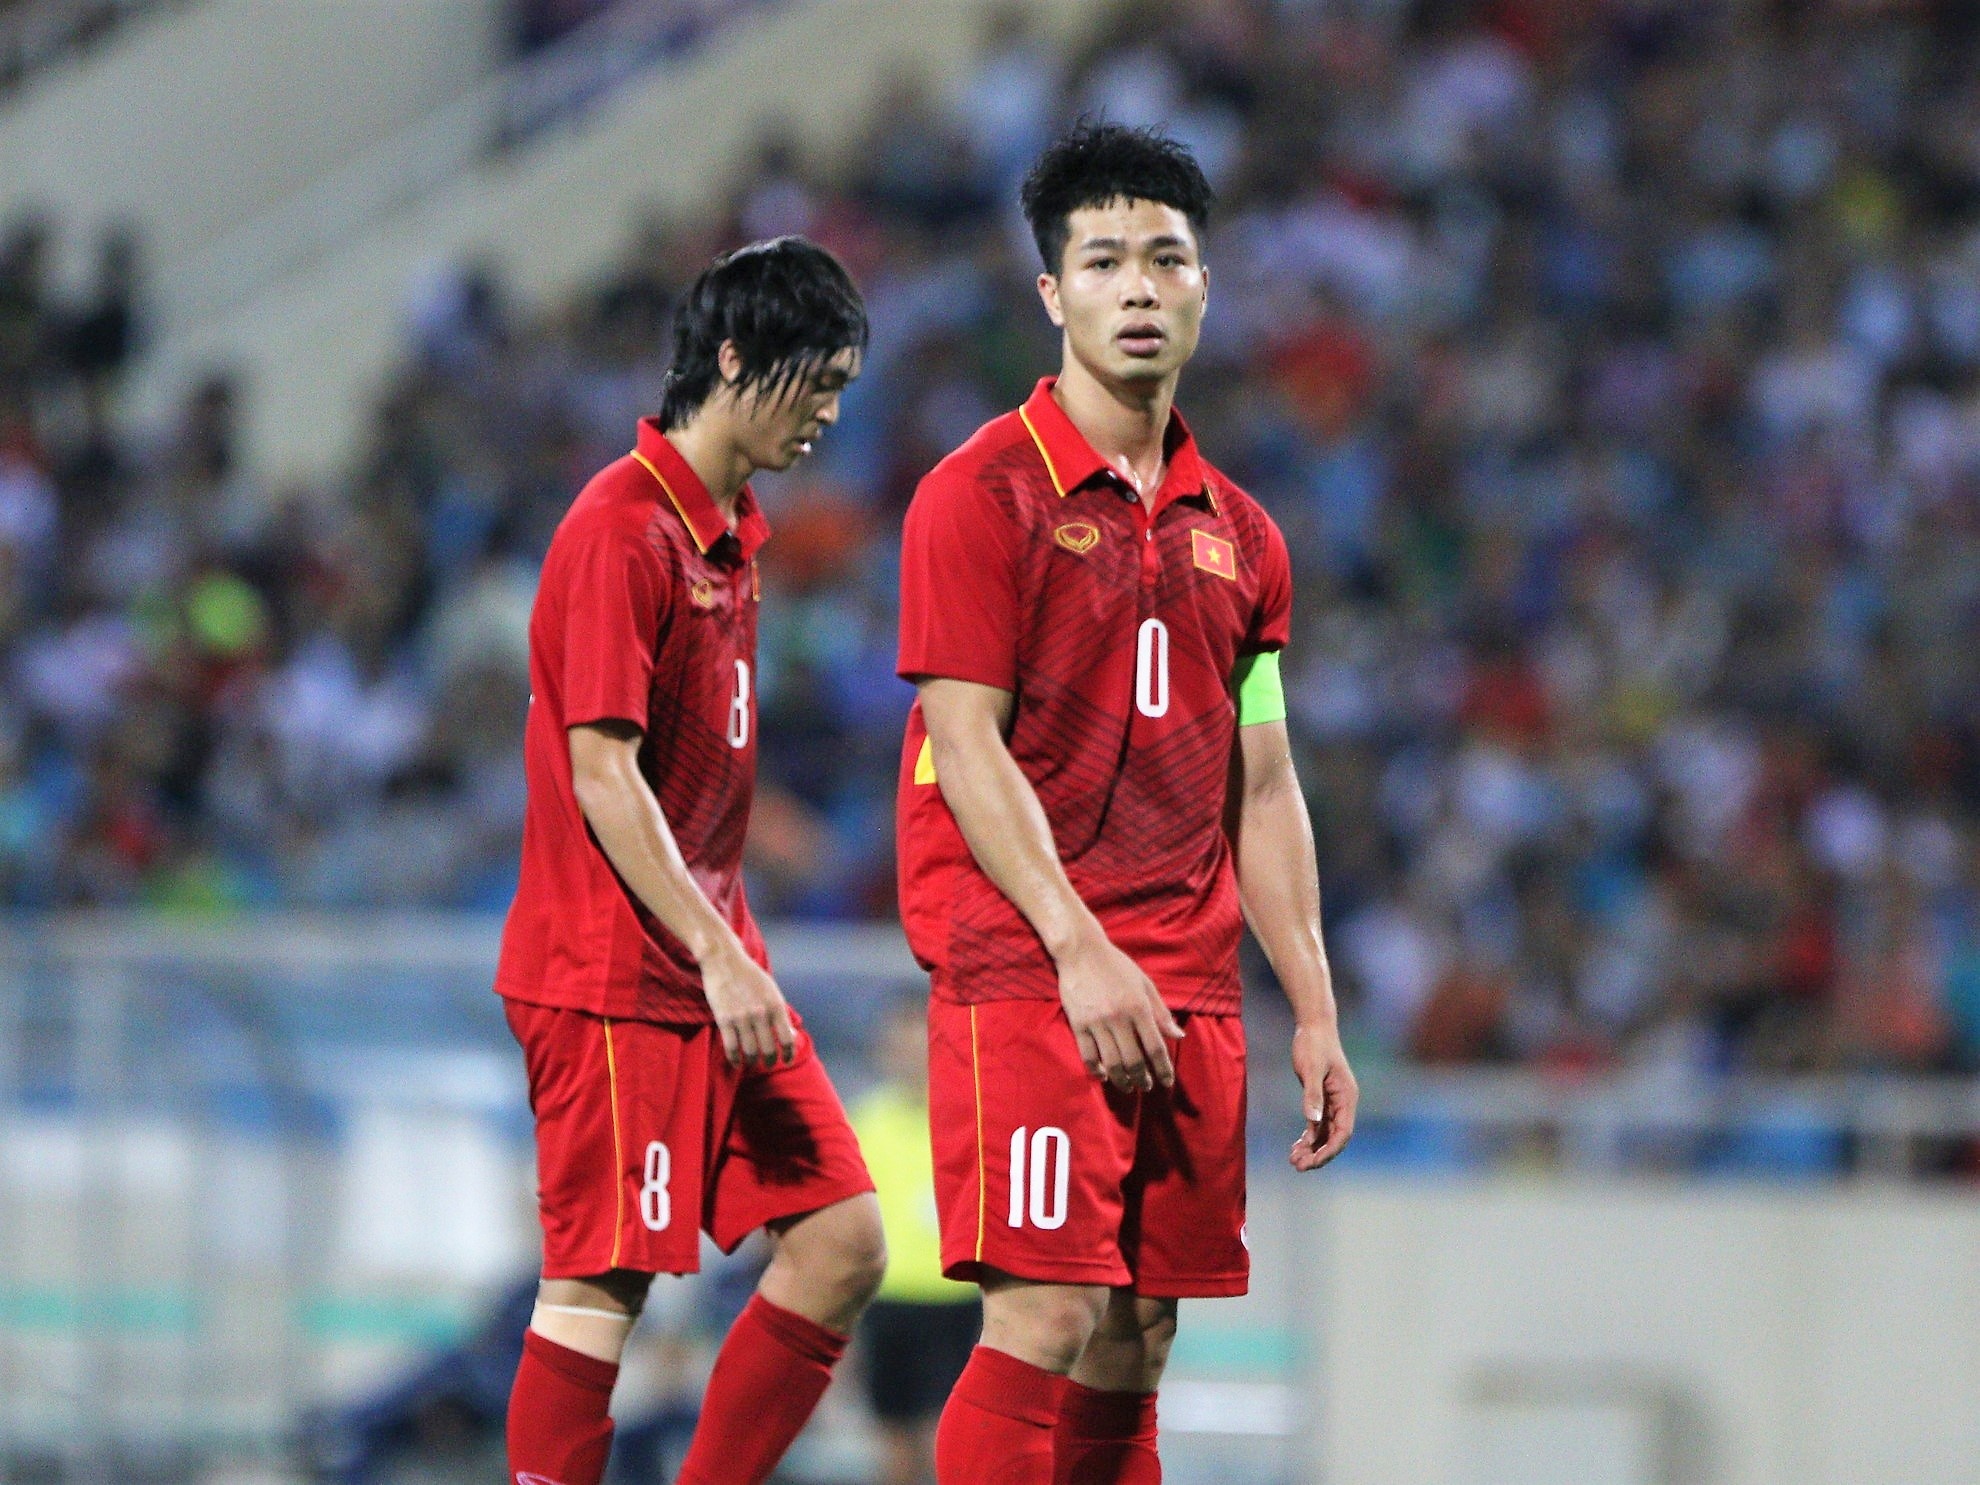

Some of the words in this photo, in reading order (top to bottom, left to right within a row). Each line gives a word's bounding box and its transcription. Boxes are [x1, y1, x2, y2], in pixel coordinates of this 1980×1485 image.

[727, 658, 750, 749] 8
[639, 1140, 671, 1232] 8
[1007, 1125, 1071, 1230] 10
